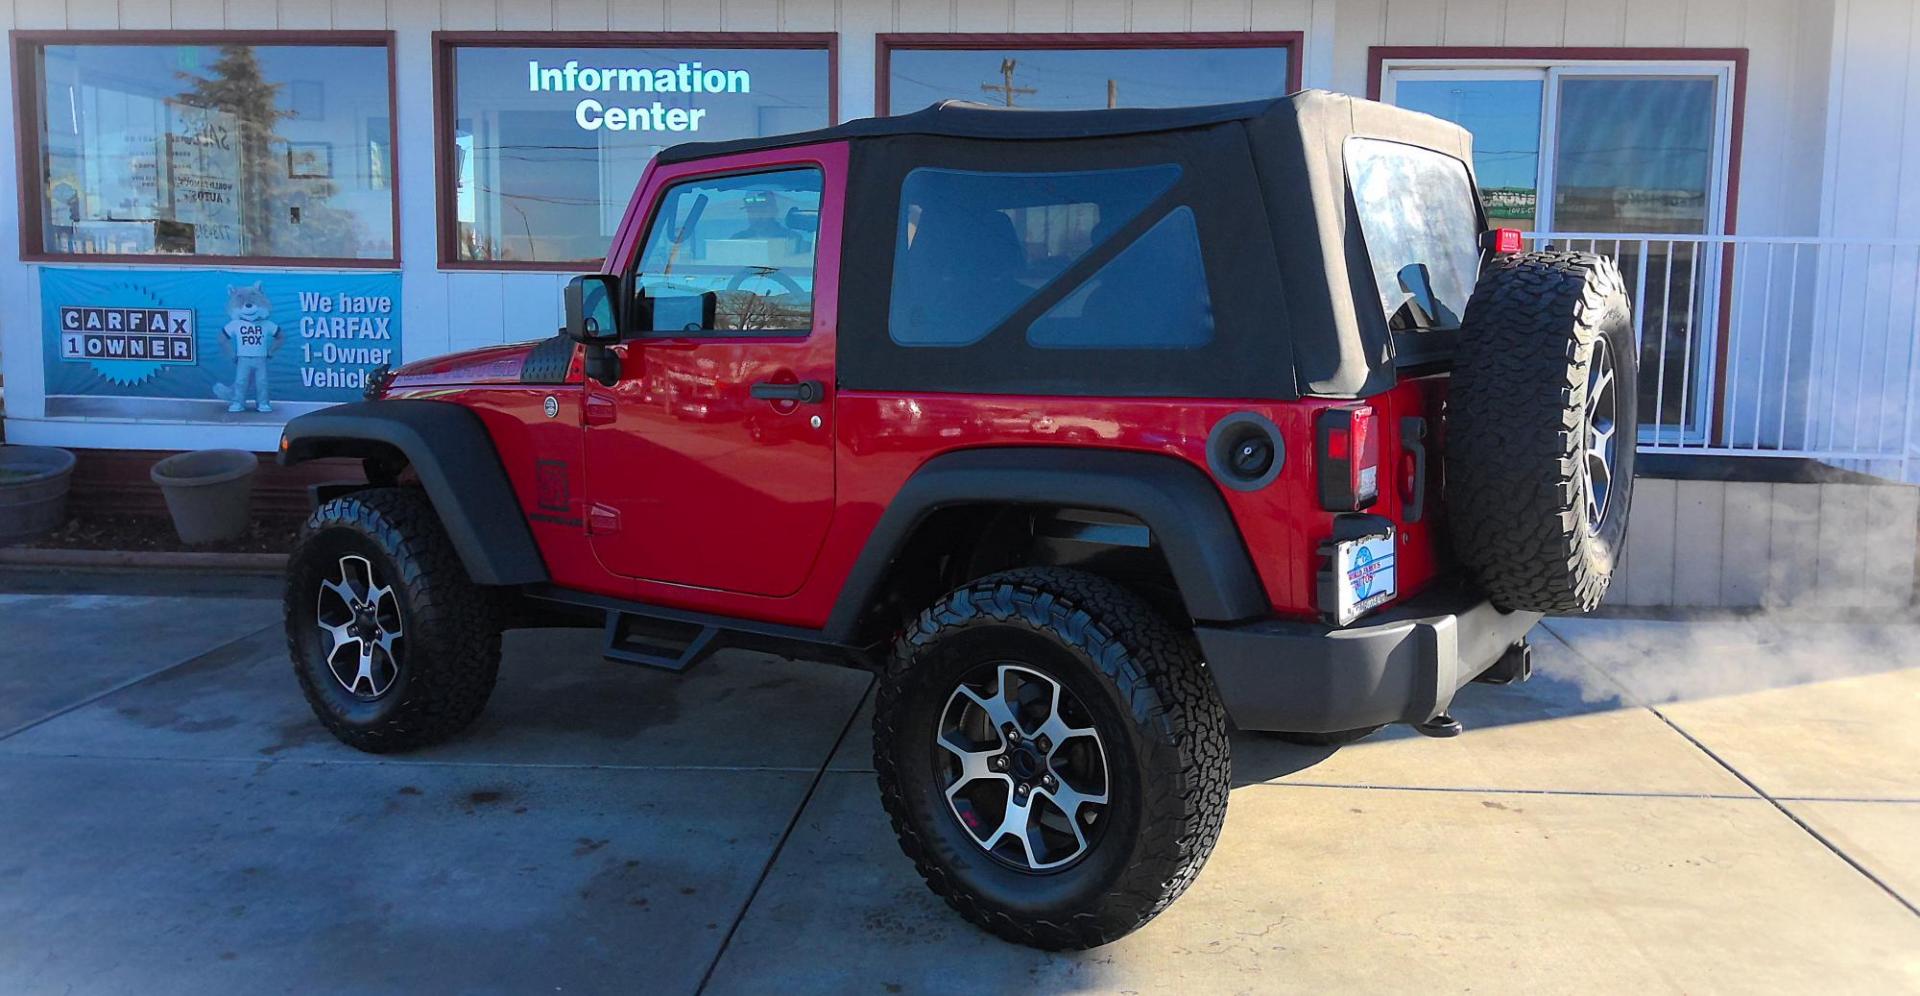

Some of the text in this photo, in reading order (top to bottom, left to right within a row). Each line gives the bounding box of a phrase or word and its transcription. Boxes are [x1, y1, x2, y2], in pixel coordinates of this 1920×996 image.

[529, 60, 751, 93] Information
[575, 98, 706, 131] Center
[299, 291, 391, 313] We have
[65, 310, 187, 334] CARFAX
[240, 325, 263, 336] CAR
[302, 316, 391, 340] CARFAX
[68, 337, 188, 357] 1 OWNER
[241, 335, 263, 346] FOX
[301, 343, 391, 365] 1-Owner
